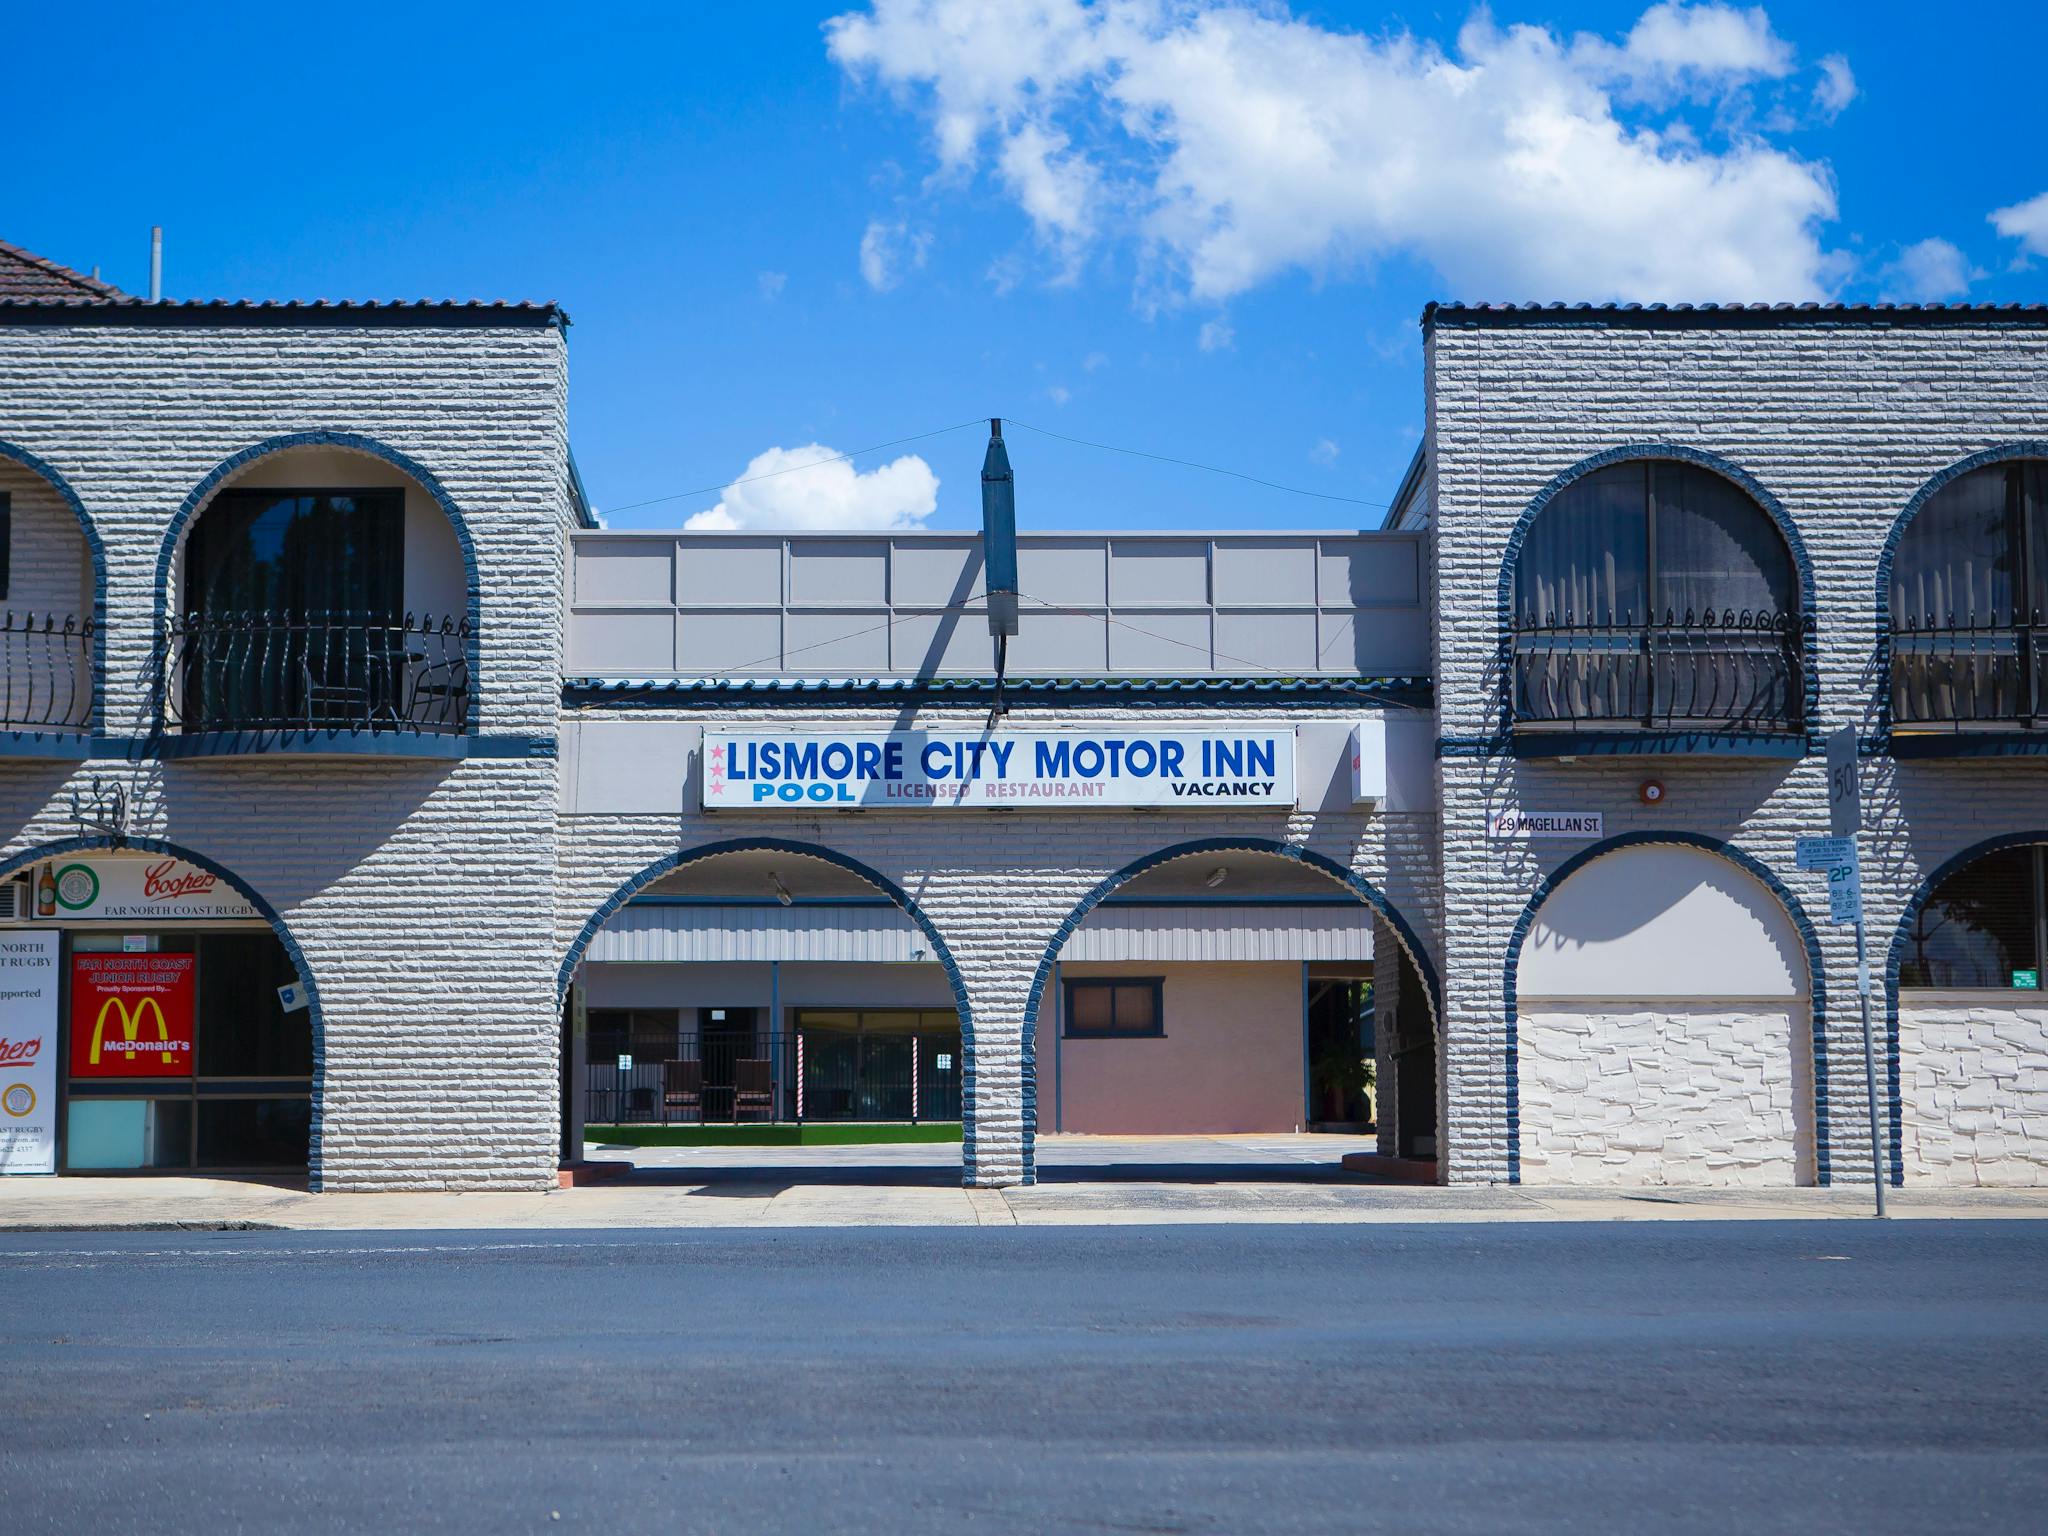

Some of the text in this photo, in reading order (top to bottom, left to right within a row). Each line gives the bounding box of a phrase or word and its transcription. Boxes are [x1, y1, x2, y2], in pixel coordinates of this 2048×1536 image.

[727, 740, 1275, 780] LISMORE CITY MOTOR INN
[753, 782, 1275, 802] POOL LICENSED RESTAURANT VACANCY
[1517, 817, 1582, 832] MAGELLAN
[1830, 866, 1853, 882] 2P
[144, 861, 217, 901] Coopers
[105, 905, 256, 915] FAR NORTH COAST RUGBY
[1, 943, 44, 953] NORTH
[10, 957, 53, 967] RUGBY
[78, 958, 193, 970] FAR NORTH COAST
[89, 971, 182, 983] JUNIOR RUGBY
[104, 1040, 190, 1051] McDonald's
